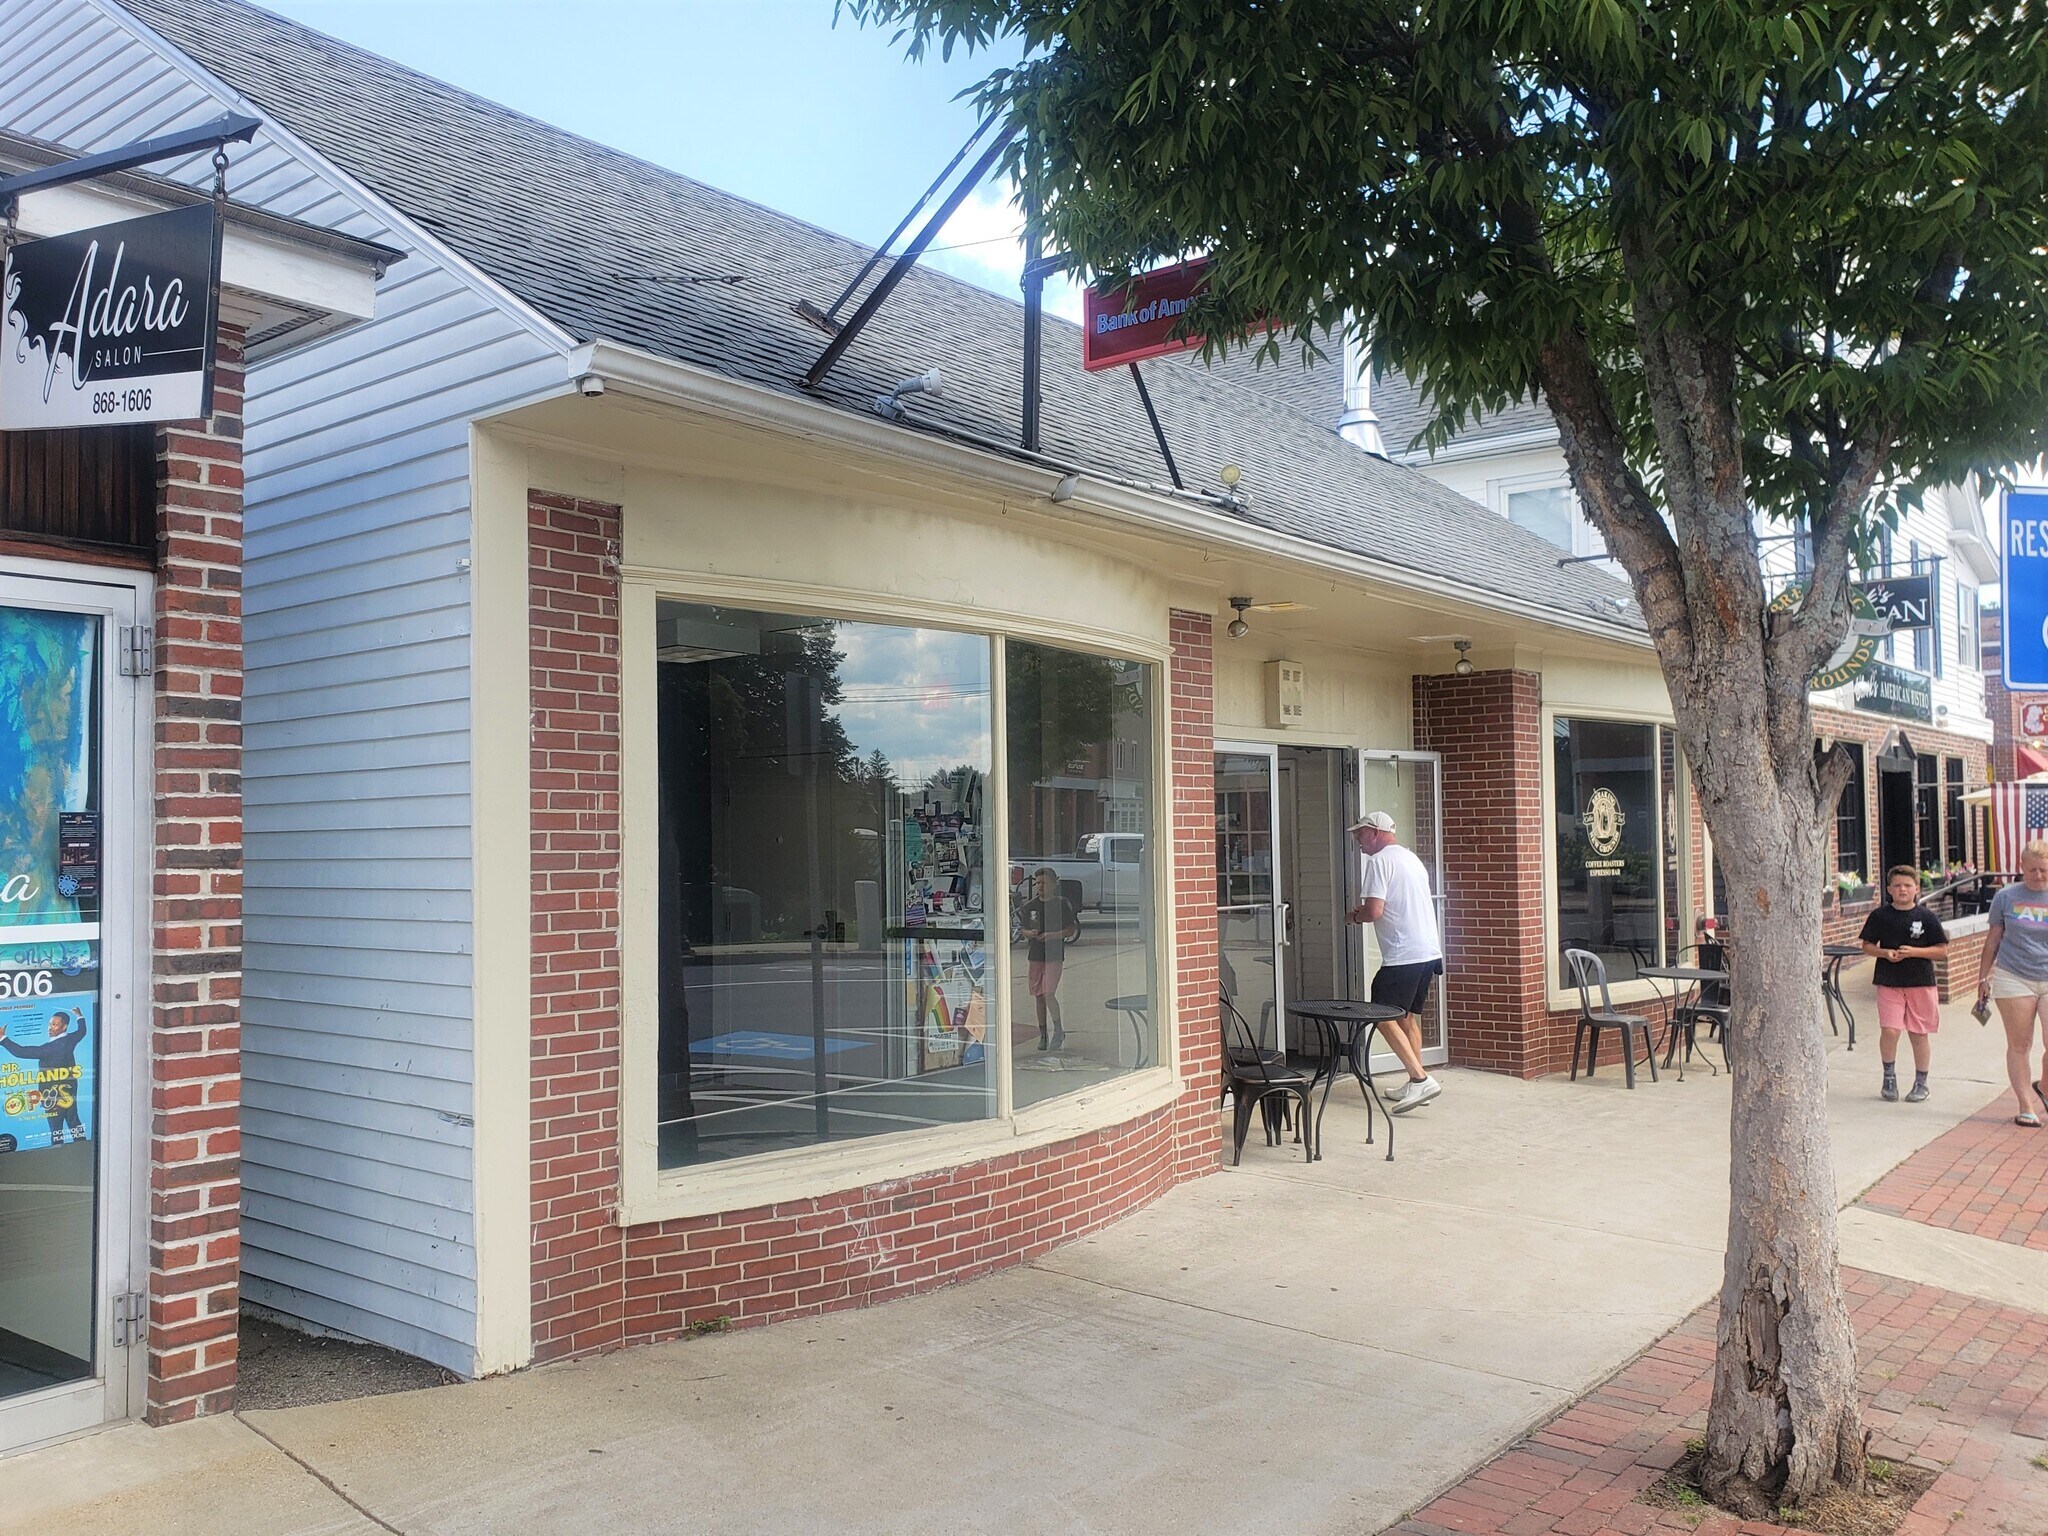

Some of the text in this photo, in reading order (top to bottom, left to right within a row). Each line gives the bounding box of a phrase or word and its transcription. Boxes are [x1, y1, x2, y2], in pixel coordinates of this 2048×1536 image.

[43, 240, 190, 404] Adara
[1097, 295, 1196, 333] Bank of Ame
[94, 346, 142, 368] SALON
[92, 388, 153, 414] 868-1606
[1875, 599, 1928, 622] CAN
[1809, 638, 1875, 690] ROUNDS
[1880, 681, 1911, 704] AMERICAN
[1910, 690, 1930, 709] BISTRO
[0, 1065, 83, 1088] HOLLAND'S
[2, 1063, 20, 1073] MR.
[4, 1084, 75, 1115] OPUS
